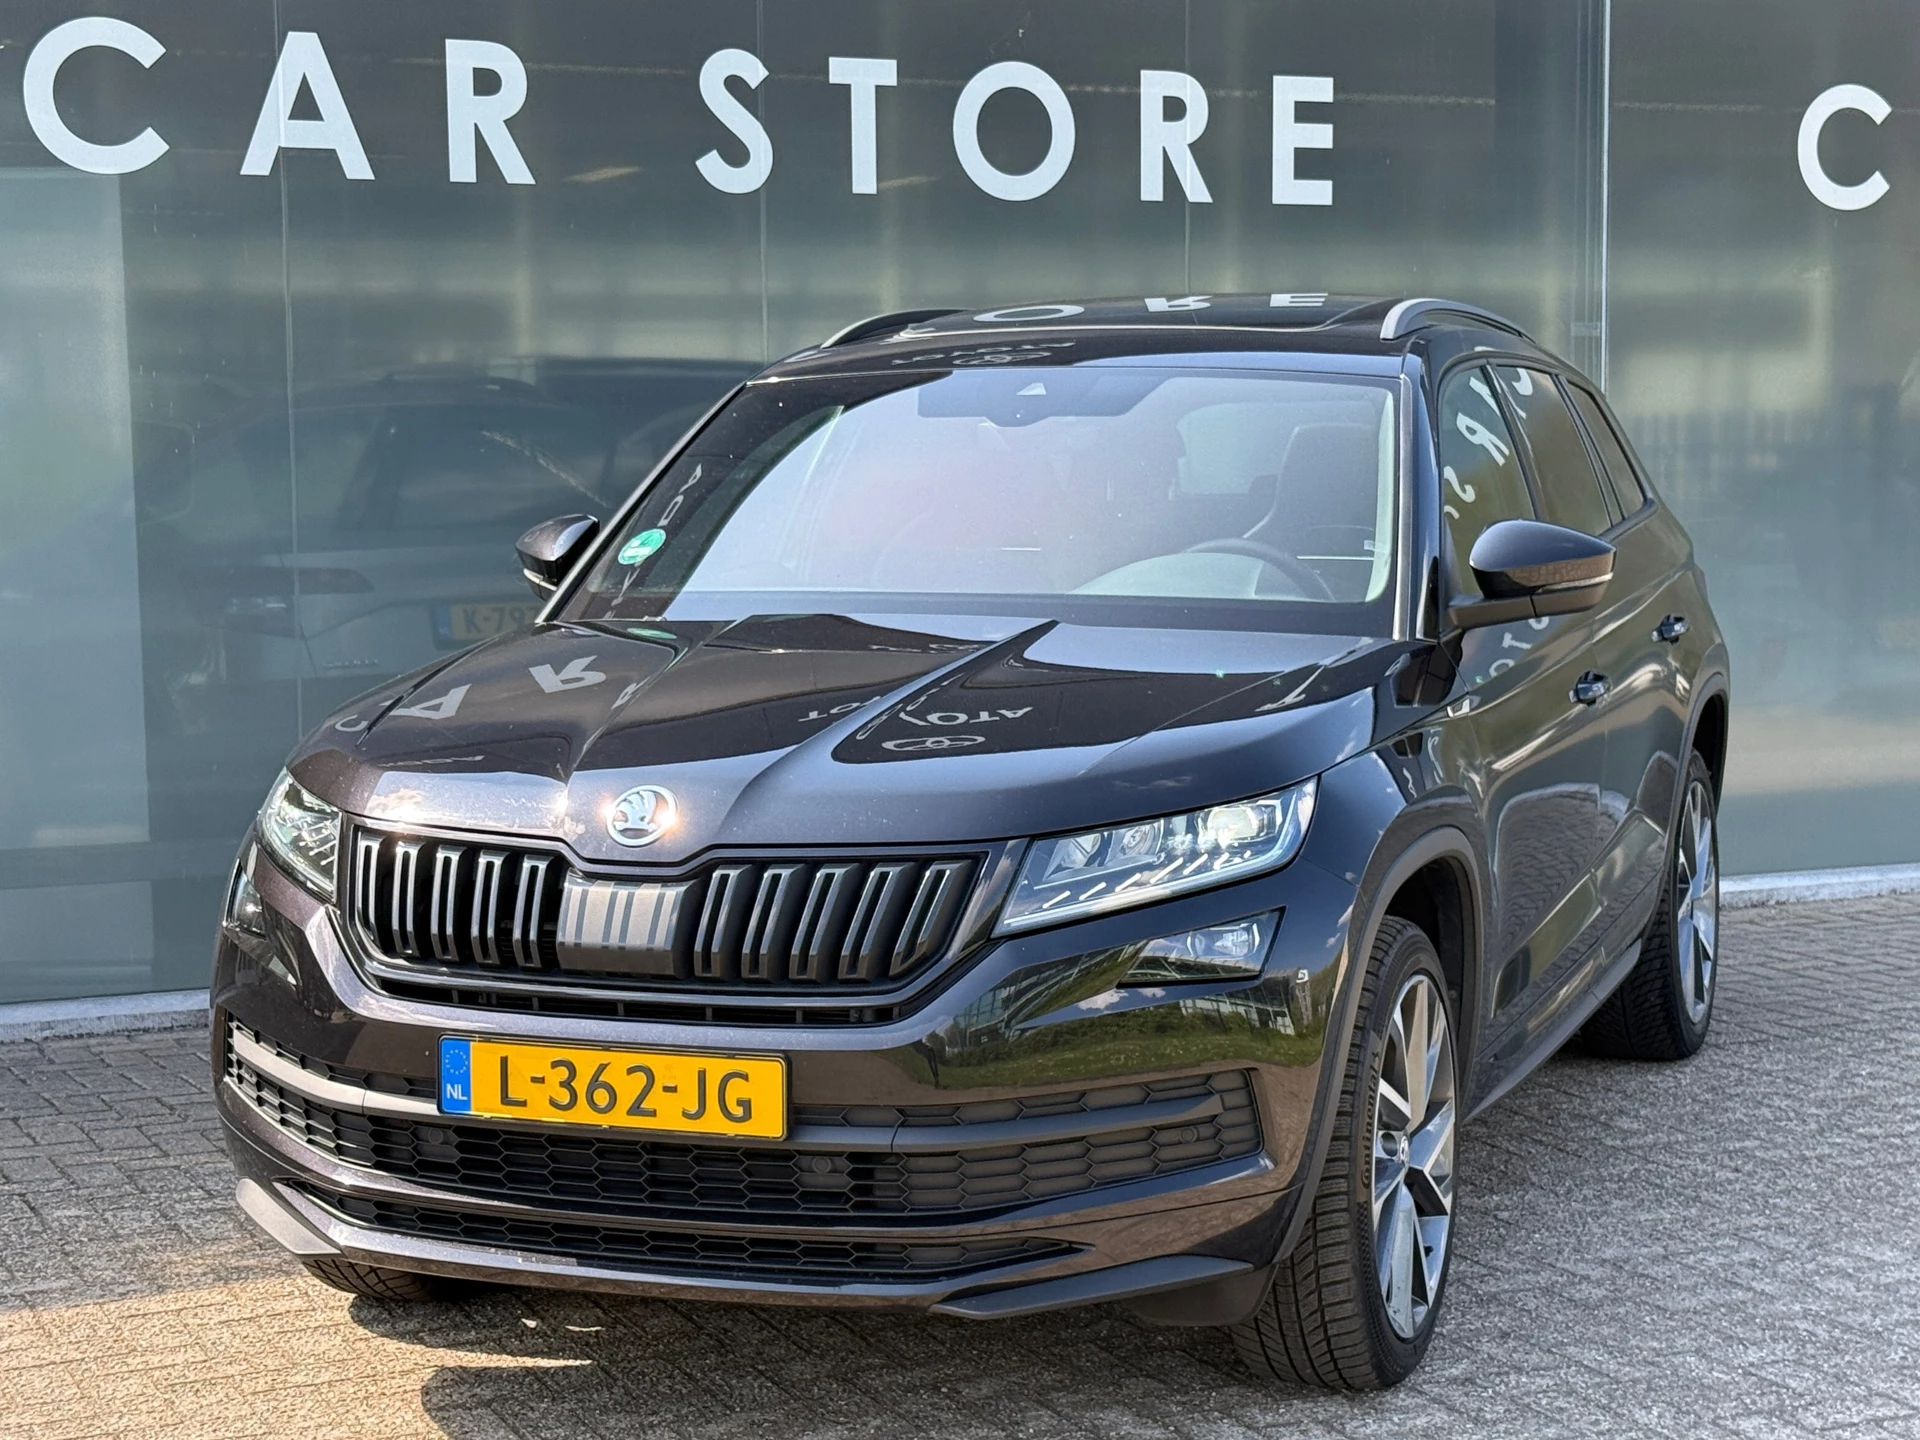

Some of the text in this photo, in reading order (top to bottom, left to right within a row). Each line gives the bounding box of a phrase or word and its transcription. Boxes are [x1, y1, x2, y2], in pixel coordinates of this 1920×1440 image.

[22, 15, 1334, 206] CAR STORE
[1796, 84, 1892, 211] C
[446, 1082, 468, 1101] NL
[499, 1055, 753, 1124] L-362-JG
[1360, 1065, 1380, 1190] Continental
